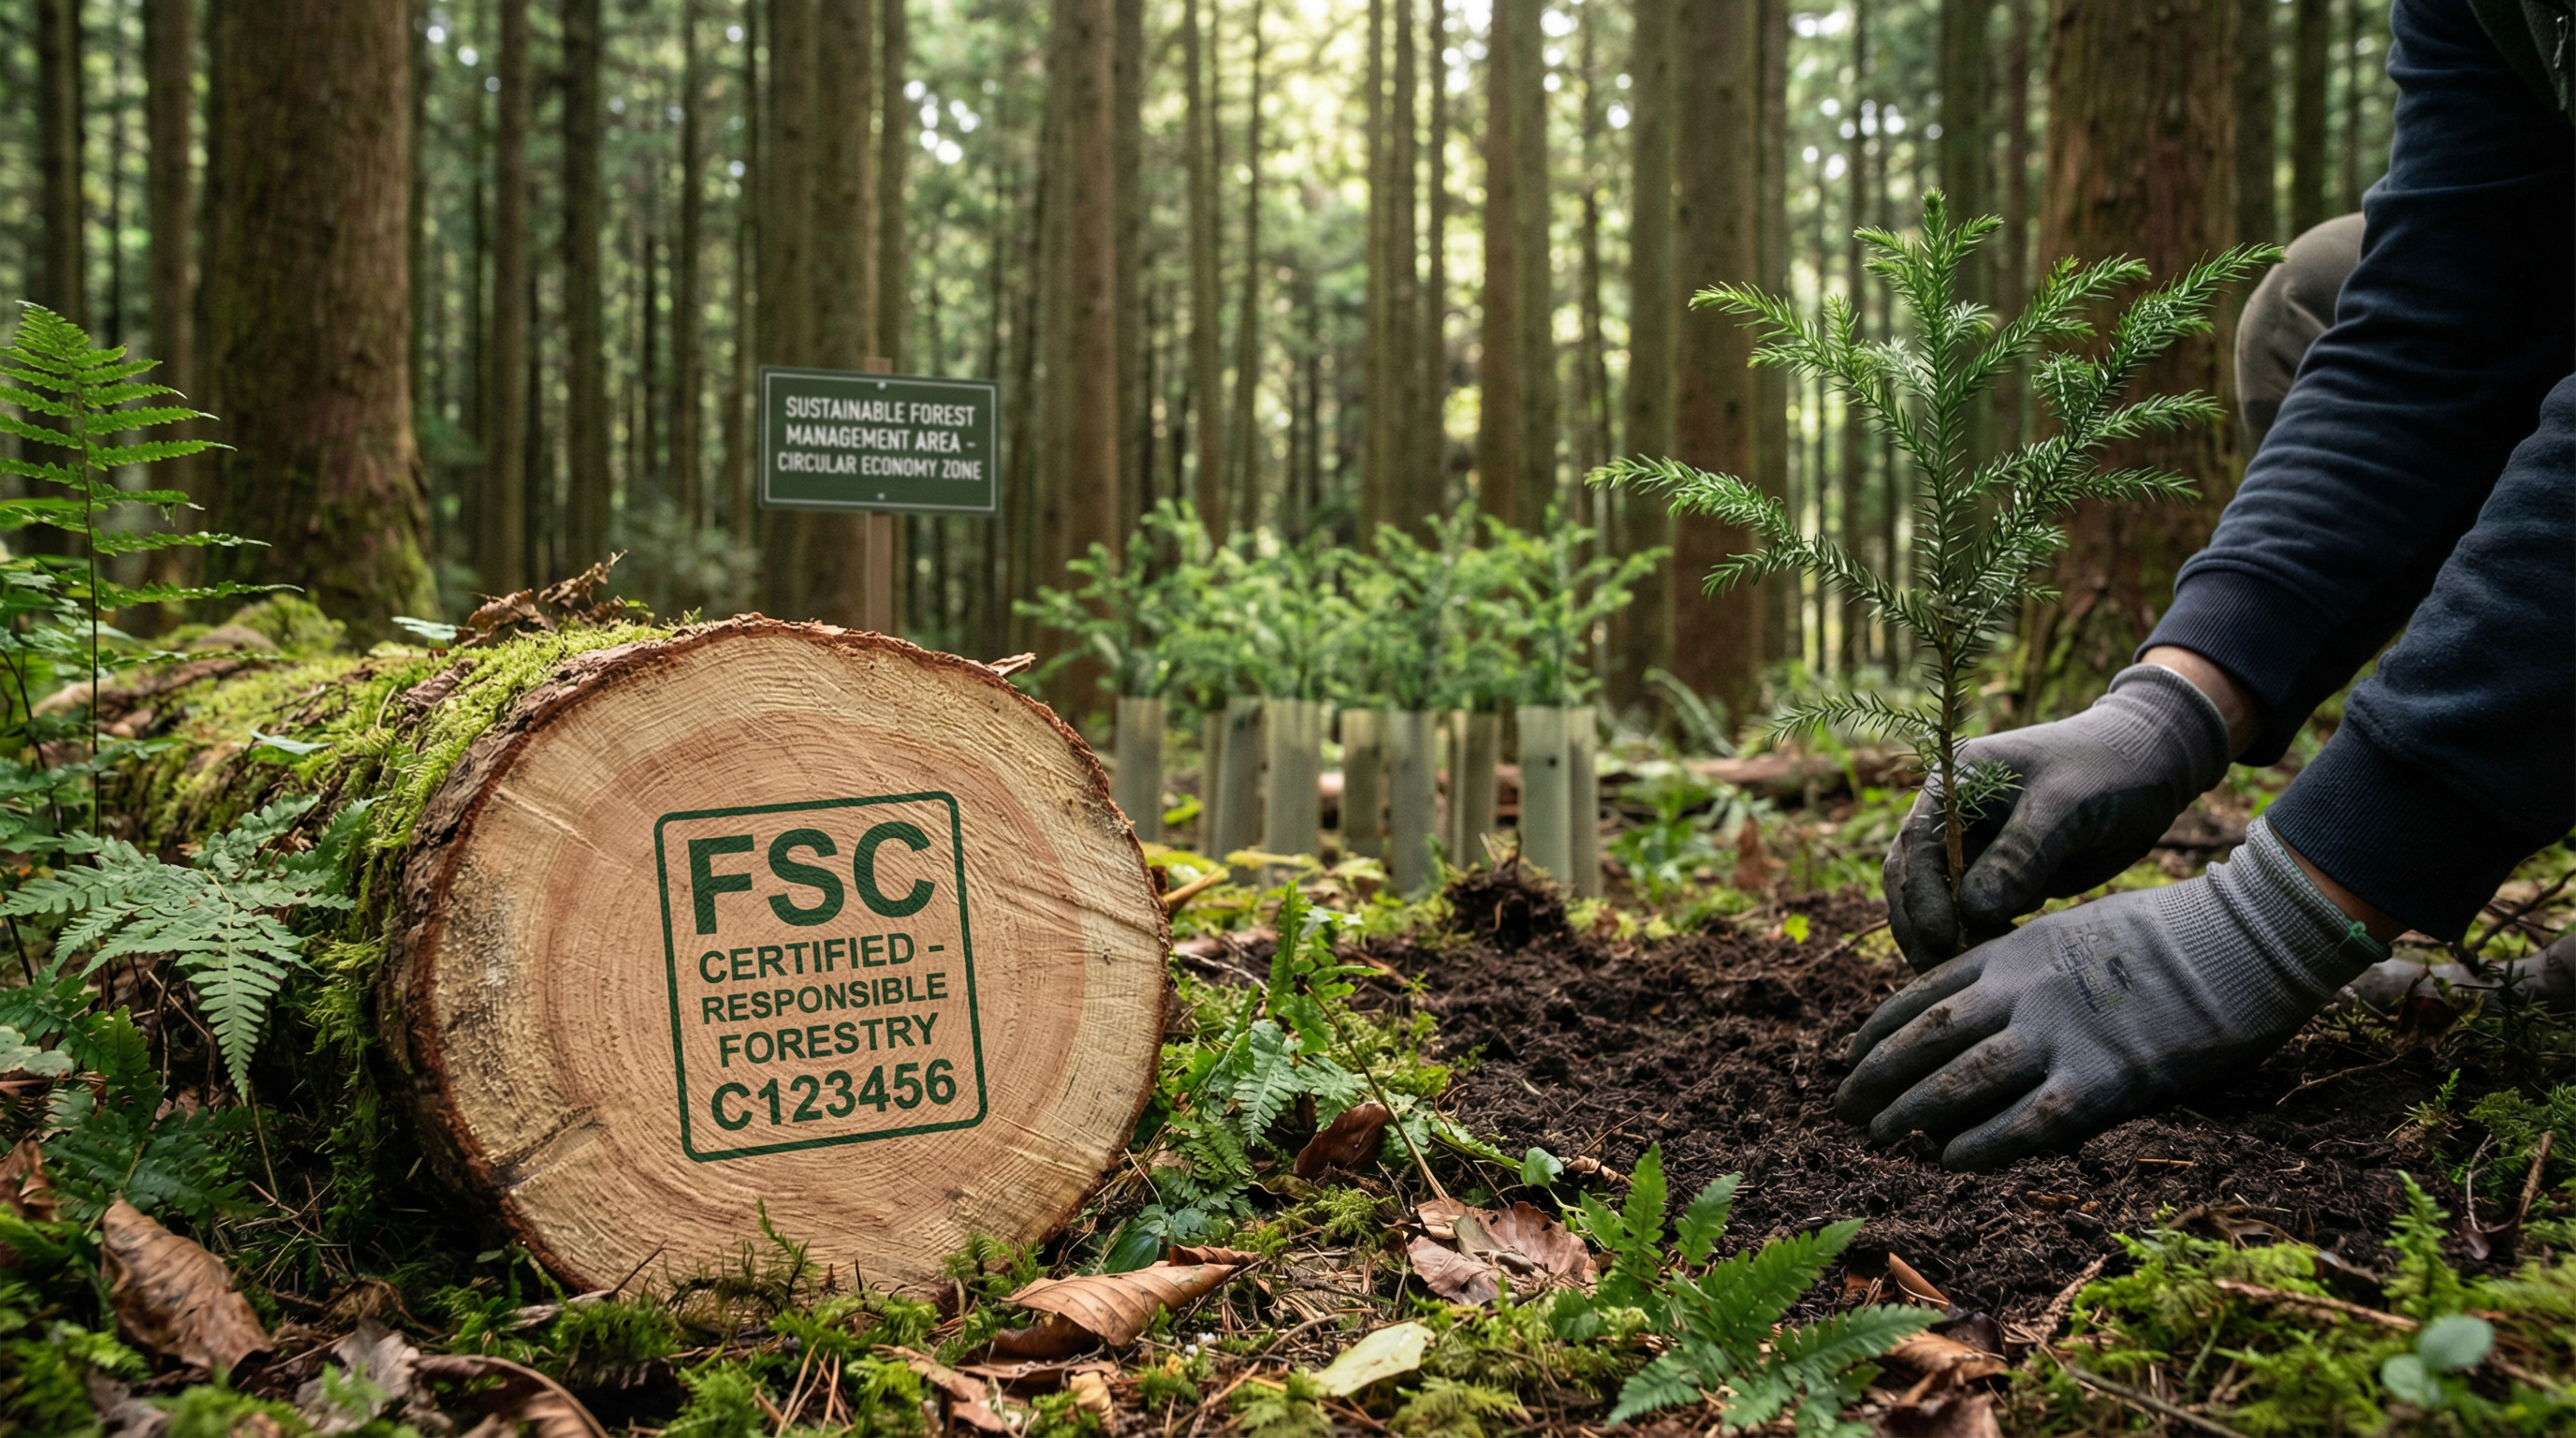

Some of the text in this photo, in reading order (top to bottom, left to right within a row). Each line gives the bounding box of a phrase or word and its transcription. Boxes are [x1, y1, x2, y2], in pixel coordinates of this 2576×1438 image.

[785, 395, 975, 427] SUSTAINABLE FOREST
[786, 423, 911, 450] MANAGEMENT
[915, 430, 961, 454] AREA
[778, 451, 983, 480] CIRCULAR ECONOMY ZONE
[688, 821, 935, 935] FSC
[698, 932, 915, 984] CERTIFIED
[701, 972, 948, 1025] RESPONSIBLE
[719, 1012, 939, 1068] FORESTRY
[710, 1058, 957, 1132] C123456
